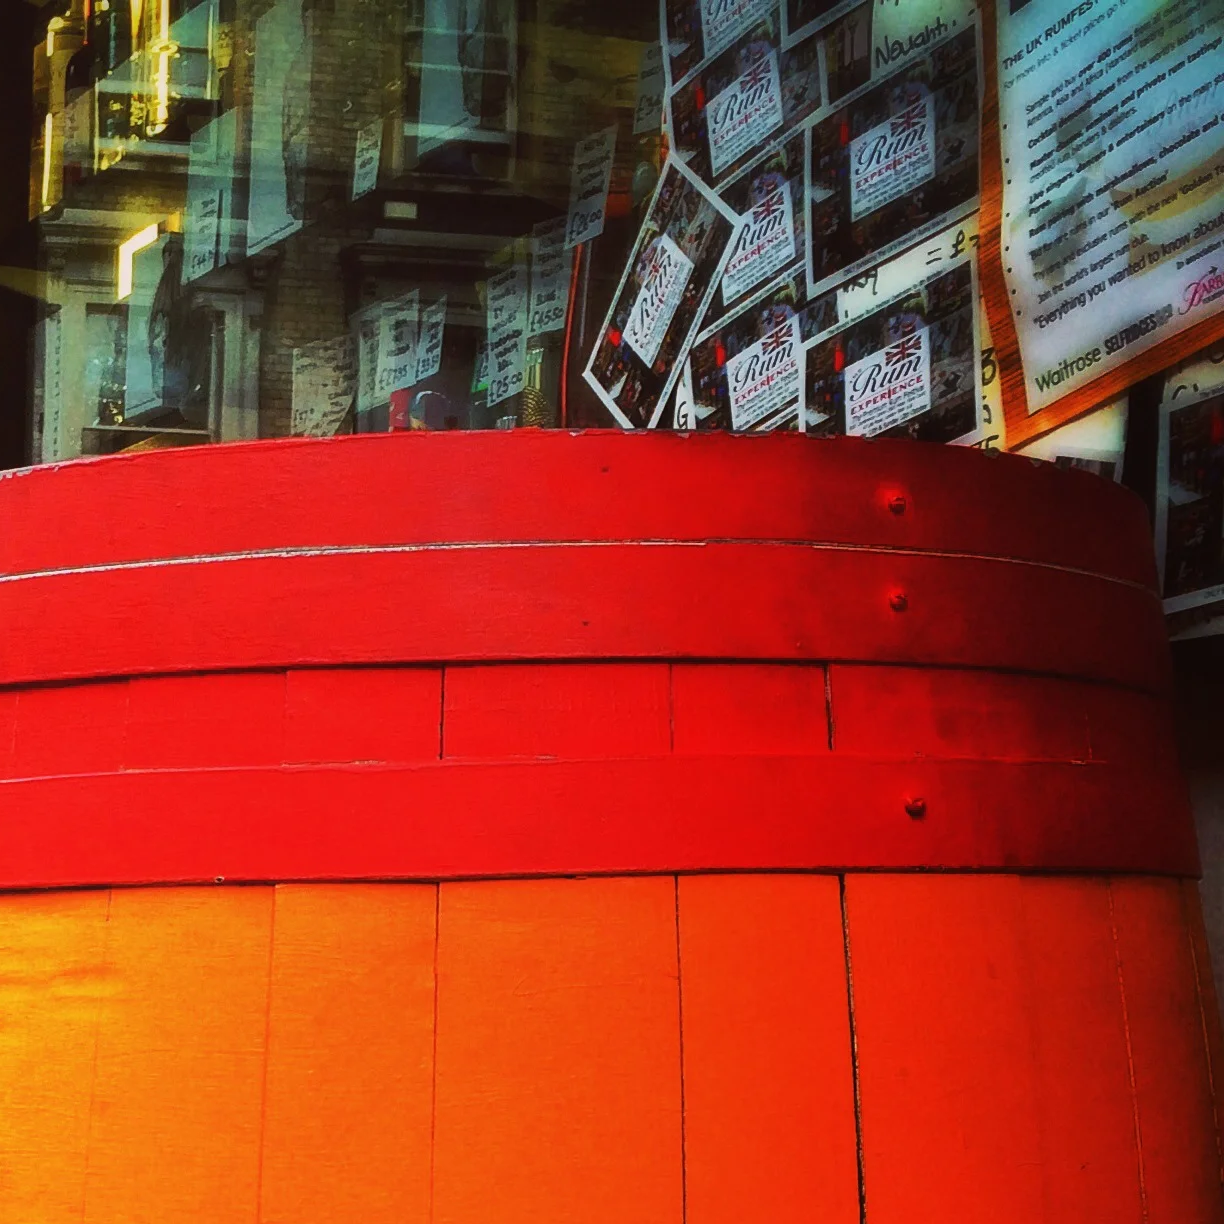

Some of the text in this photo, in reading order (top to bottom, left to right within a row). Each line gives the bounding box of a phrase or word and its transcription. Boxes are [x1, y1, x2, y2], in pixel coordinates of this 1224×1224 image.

[1002, 50, 1024, 70] THE
[1026, 34, 1042, 54] UK
[713, 77, 772, 135] Rum
[855, 123, 927, 176] Rum
[856, 143, 928, 189] EXPERIENCE
[1087, 280, 1104, 300] you
[1108, 258, 1144, 286] wanted
[1148, 250, 1160, 264] to
[1161, 232, 1189, 256] know
[733, 342, 793, 393] Rum
[734, 360, 797, 405] EXPERIENCE
[849, 355, 922, 402] Rum
[1034, 348, 1100, 392] Waitrose
[851, 374, 923, 416] EXPERIENCE
